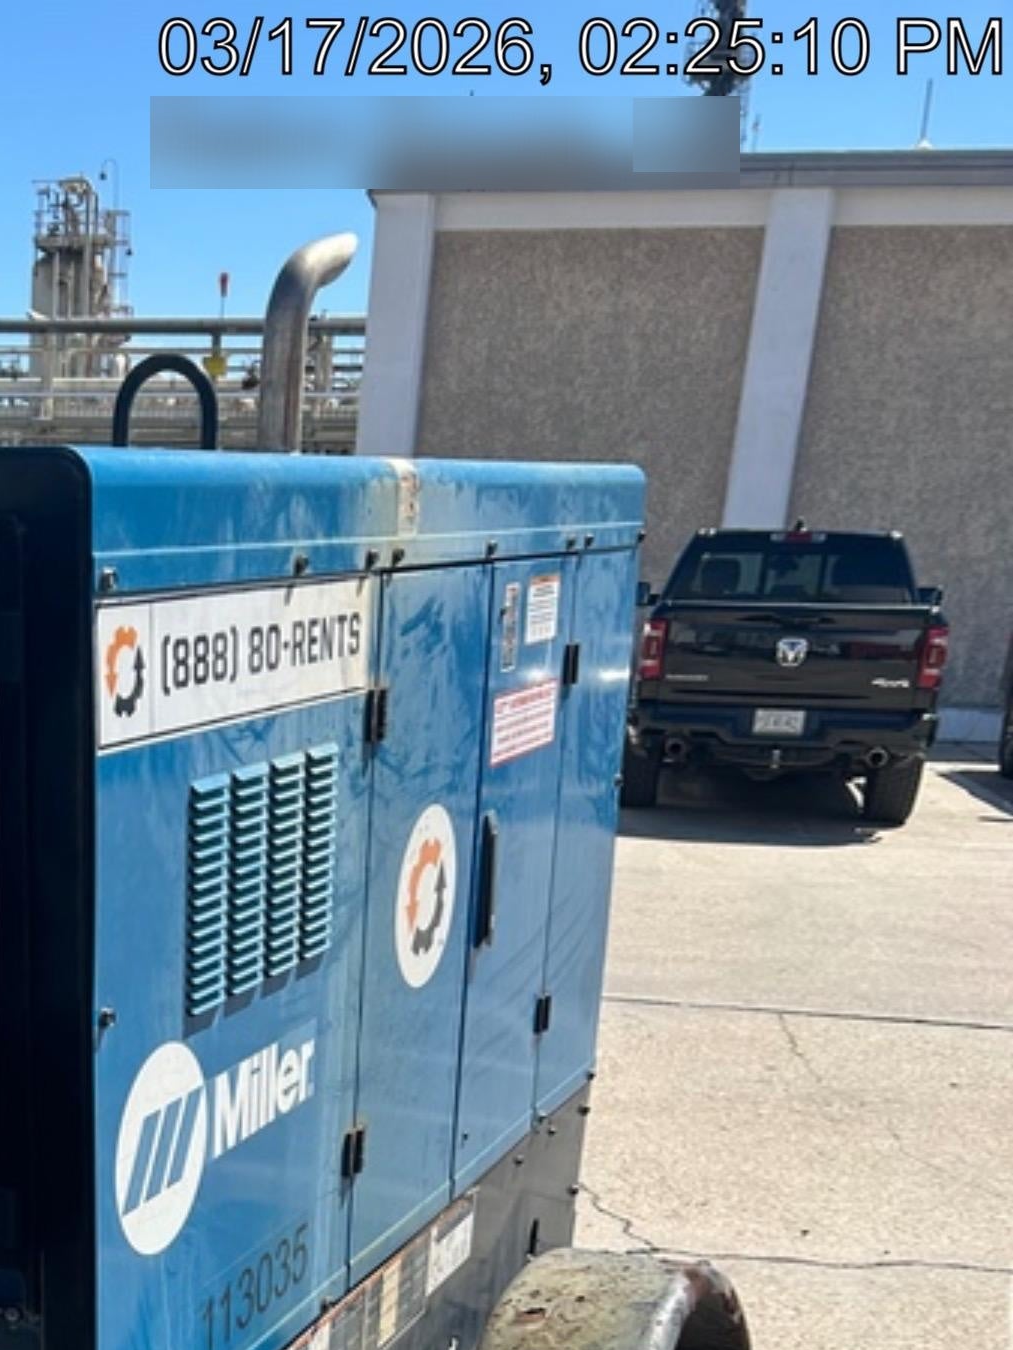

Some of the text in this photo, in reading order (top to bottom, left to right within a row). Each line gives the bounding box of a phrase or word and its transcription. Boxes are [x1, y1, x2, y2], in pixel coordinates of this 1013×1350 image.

[161, 611, 361, 697] (888) 80-RENTS
[213, 1038, 315, 1159] Miller
